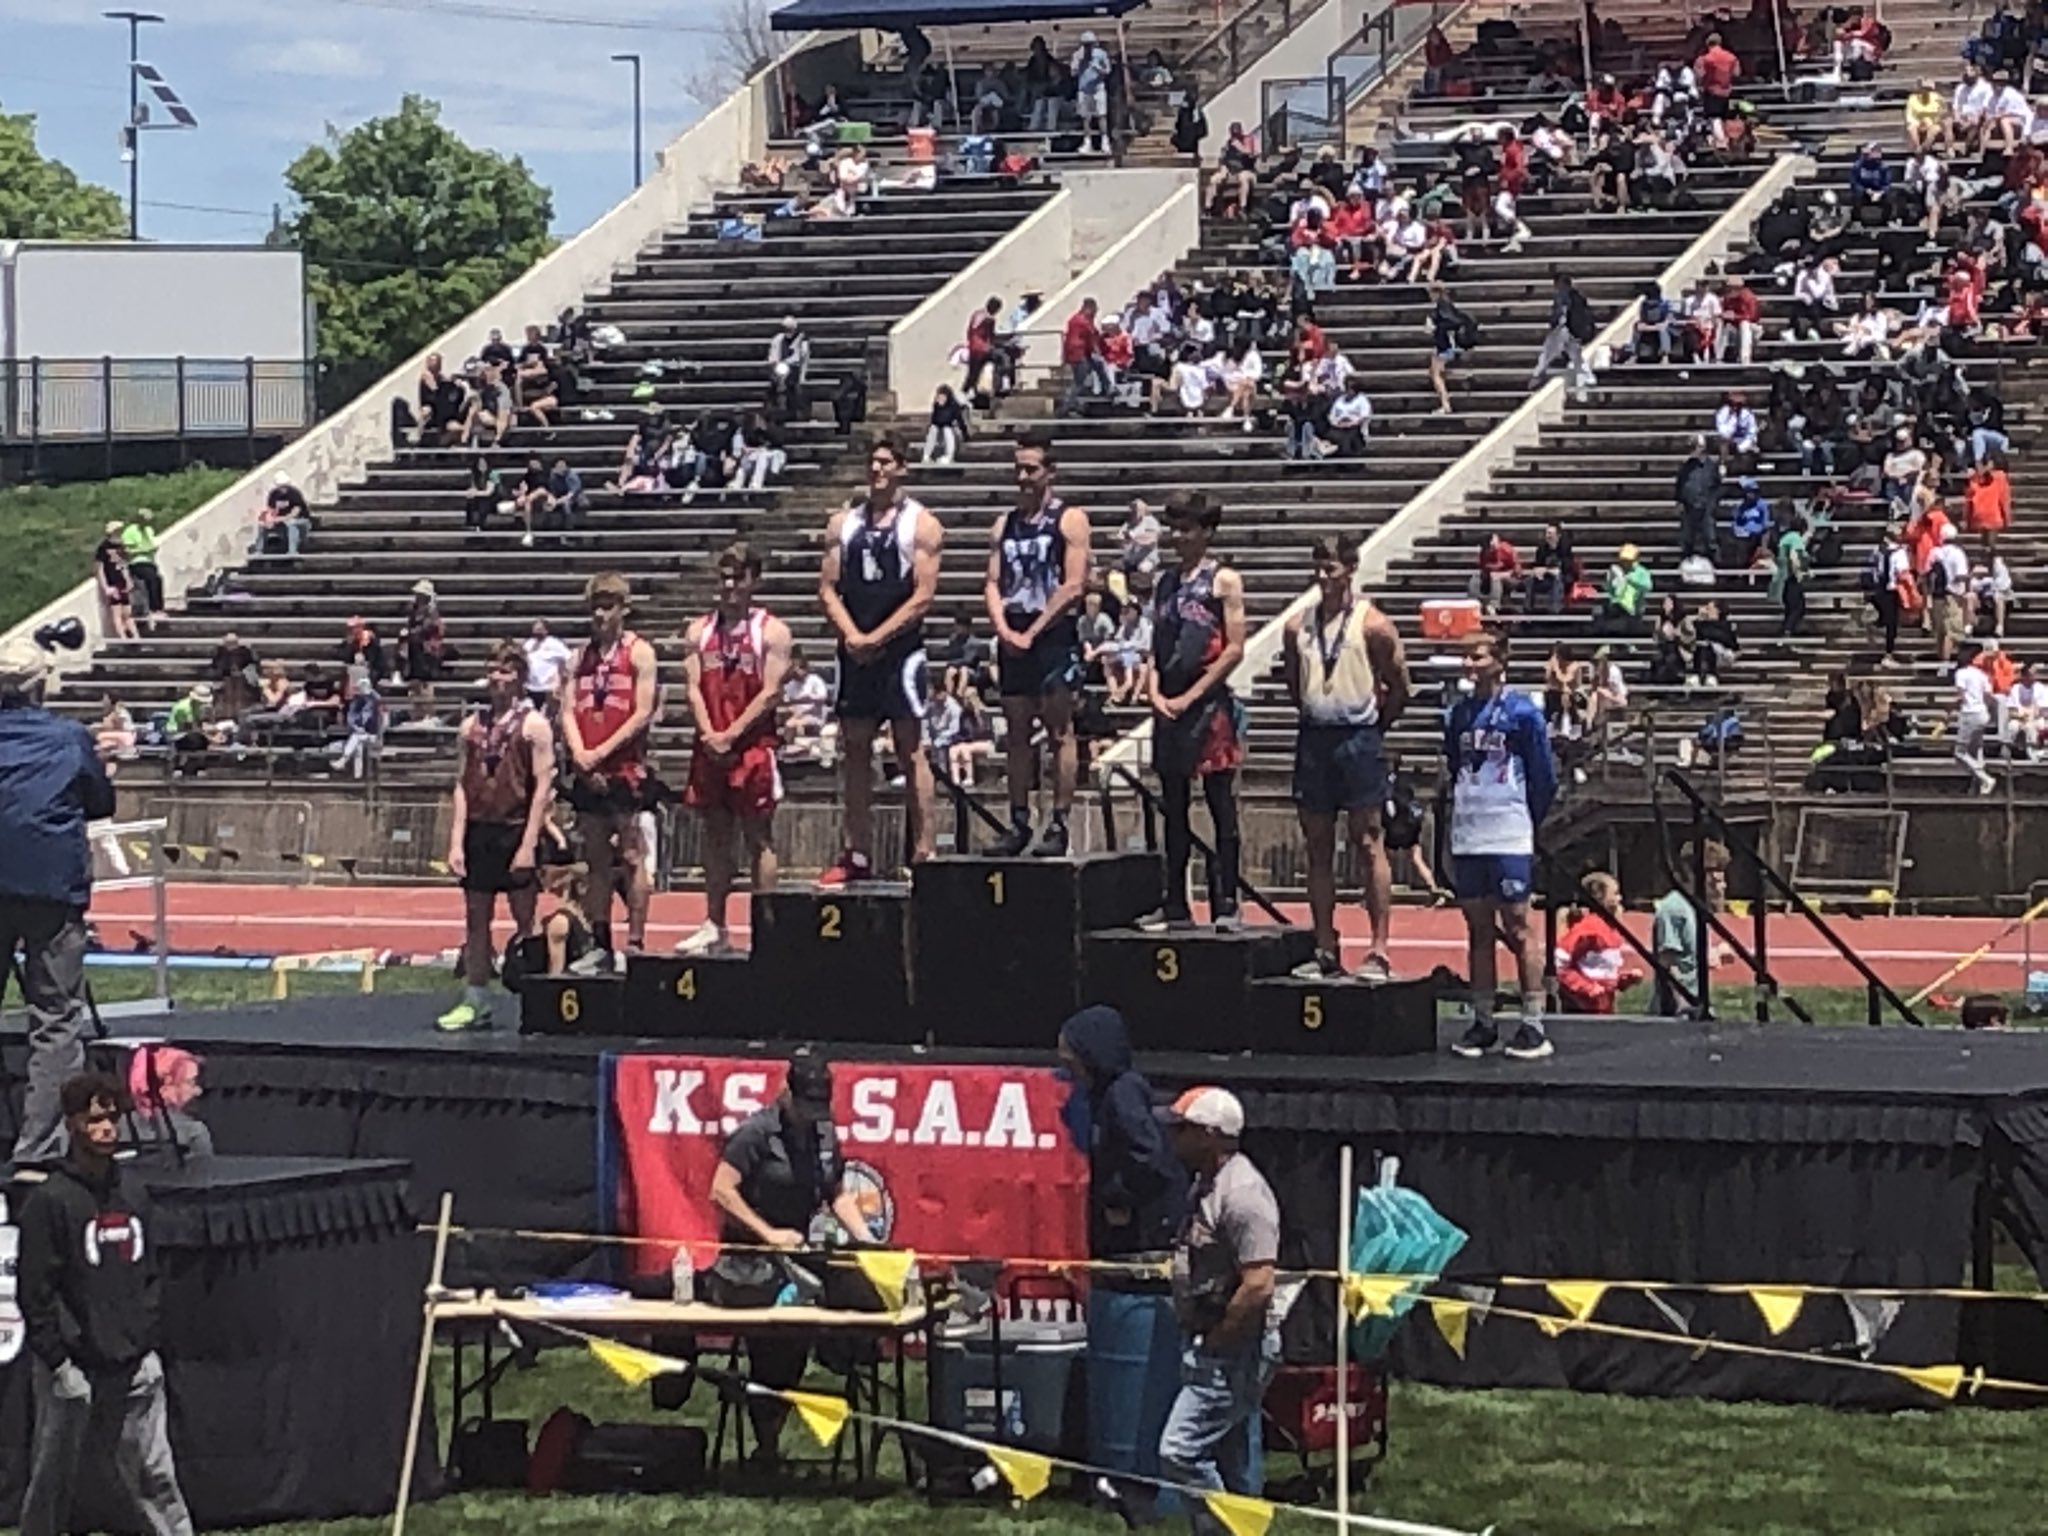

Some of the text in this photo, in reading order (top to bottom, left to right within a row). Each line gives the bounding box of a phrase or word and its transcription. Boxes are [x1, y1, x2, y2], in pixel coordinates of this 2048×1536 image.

[987, 871, 1004, 904] 1
[821, 904, 842, 937] 2
[1156, 948, 1179, 982] 3
[677, 968, 696, 1000] 4
[560, 988, 580, 1022] 6
[1303, 995, 1324, 1029] 5
